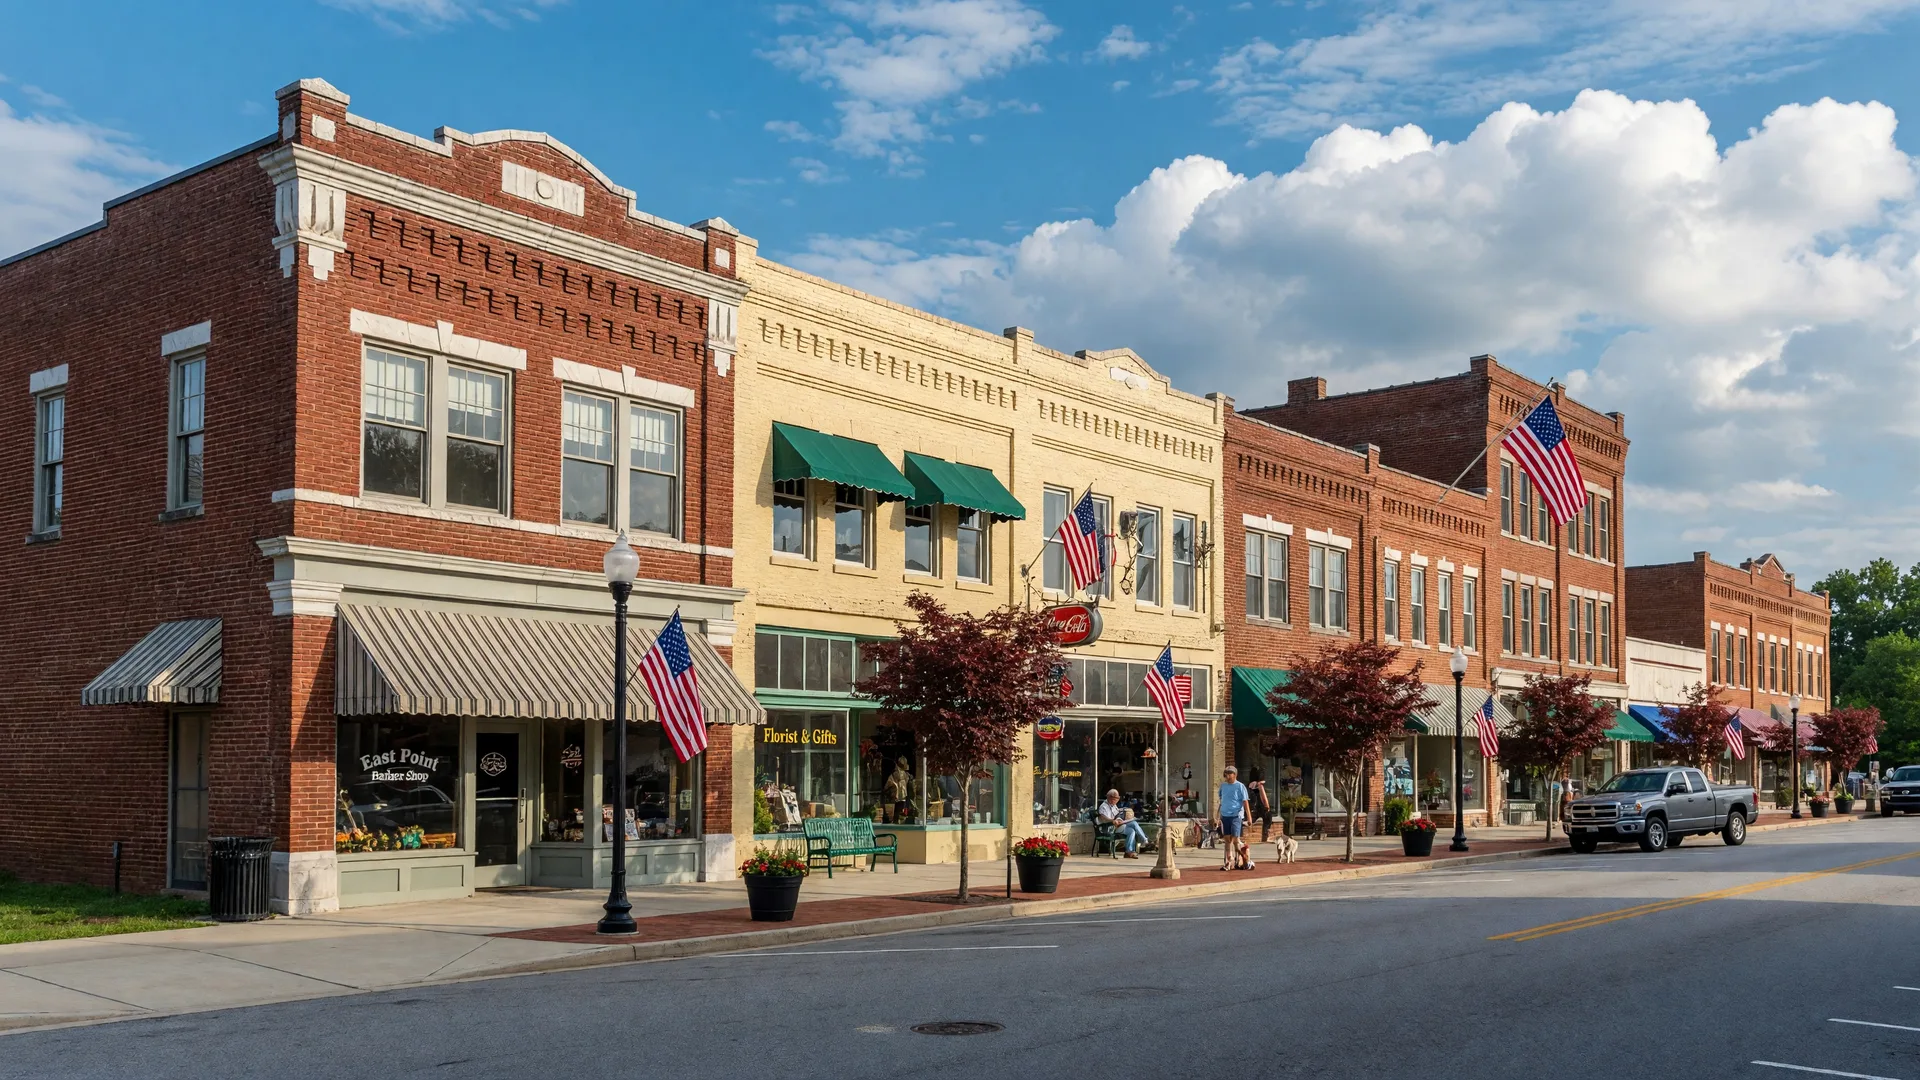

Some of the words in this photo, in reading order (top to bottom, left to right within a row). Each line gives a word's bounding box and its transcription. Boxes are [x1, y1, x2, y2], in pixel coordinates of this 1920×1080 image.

[763, 728, 798, 743] Florist
[801, 729, 811, 744] &
[812, 729, 837, 744] Gifts
[360, 749, 396, 771] East
[400, 748, 439, 772] Point
[405, 770, 429, 783] Shop
